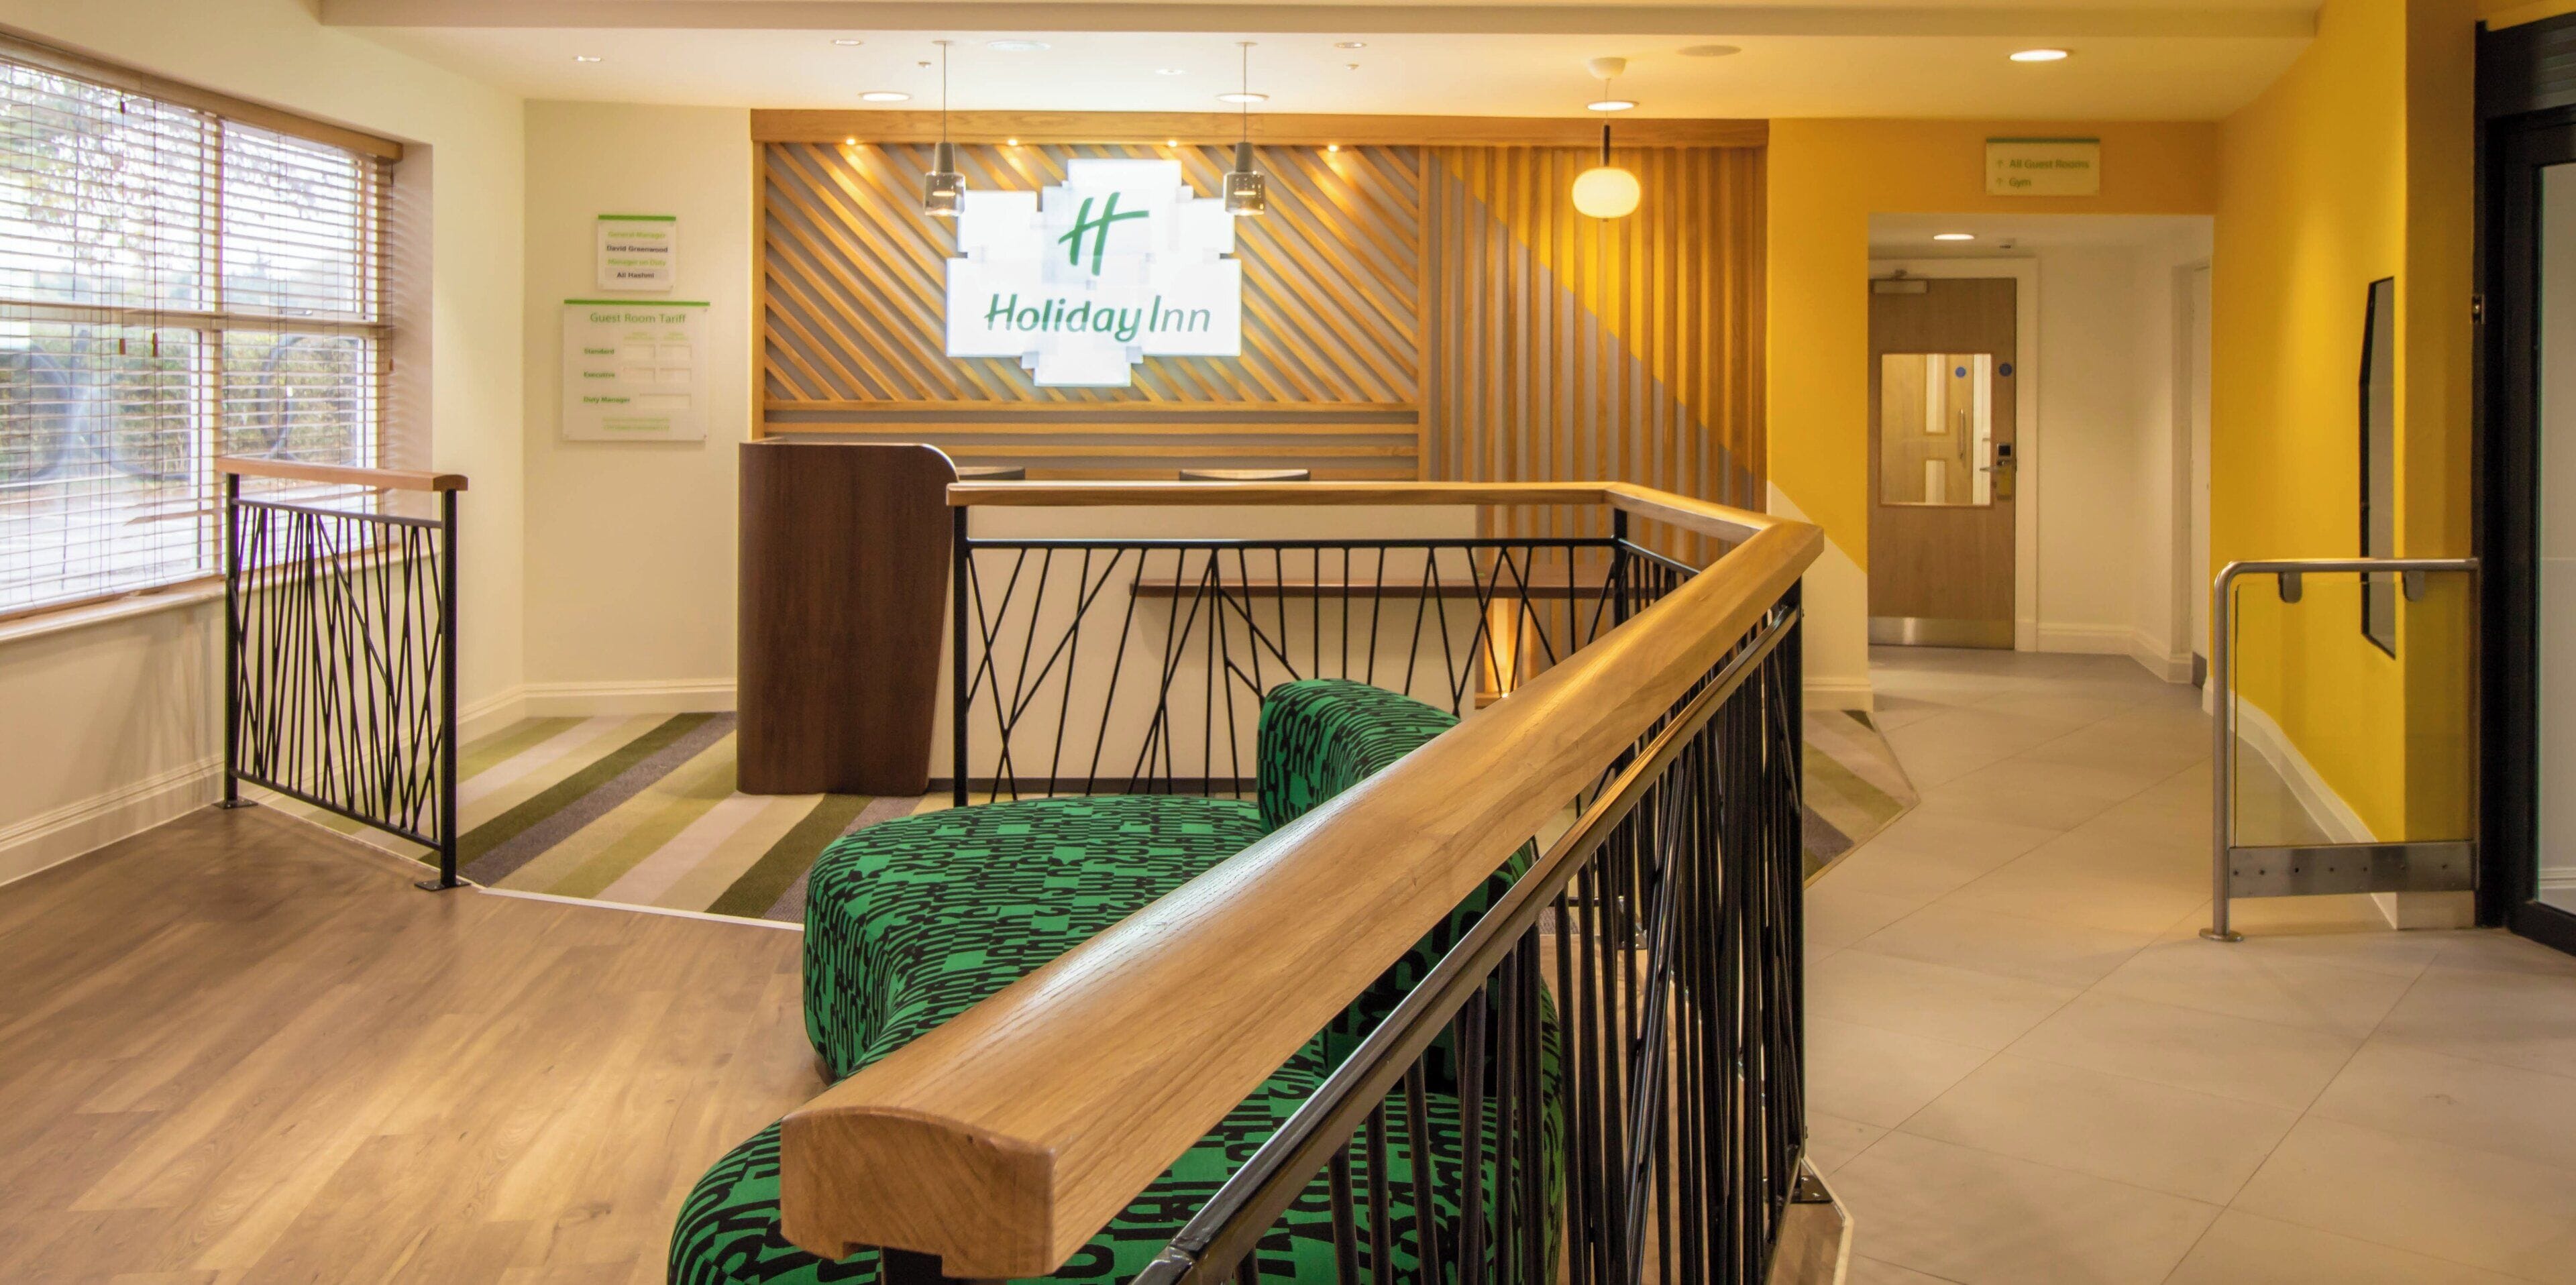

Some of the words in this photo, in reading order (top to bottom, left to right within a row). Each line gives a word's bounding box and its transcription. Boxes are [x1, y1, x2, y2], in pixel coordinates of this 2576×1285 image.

[2009, 159, 2022, 168] All
[2025, 159, 2053, 169] Guest
[2055, 160, 2090, 169] Rooms
[2009, 177, 2032, 188] Gym
[1058, 192, 1150, 276] H
[608, 258, 637, 266] Manager
[590, 312, 621, 323] Guest
[625, 313, 655, 323] Room
[659, 313, 686, 323] Tariff
[983, 293, 1142, 343] Holiday
[1148, 295, 1212, 333] Inn
[584, 347, 615, 355] Standard
[601, 396, 631, 404] Manager
